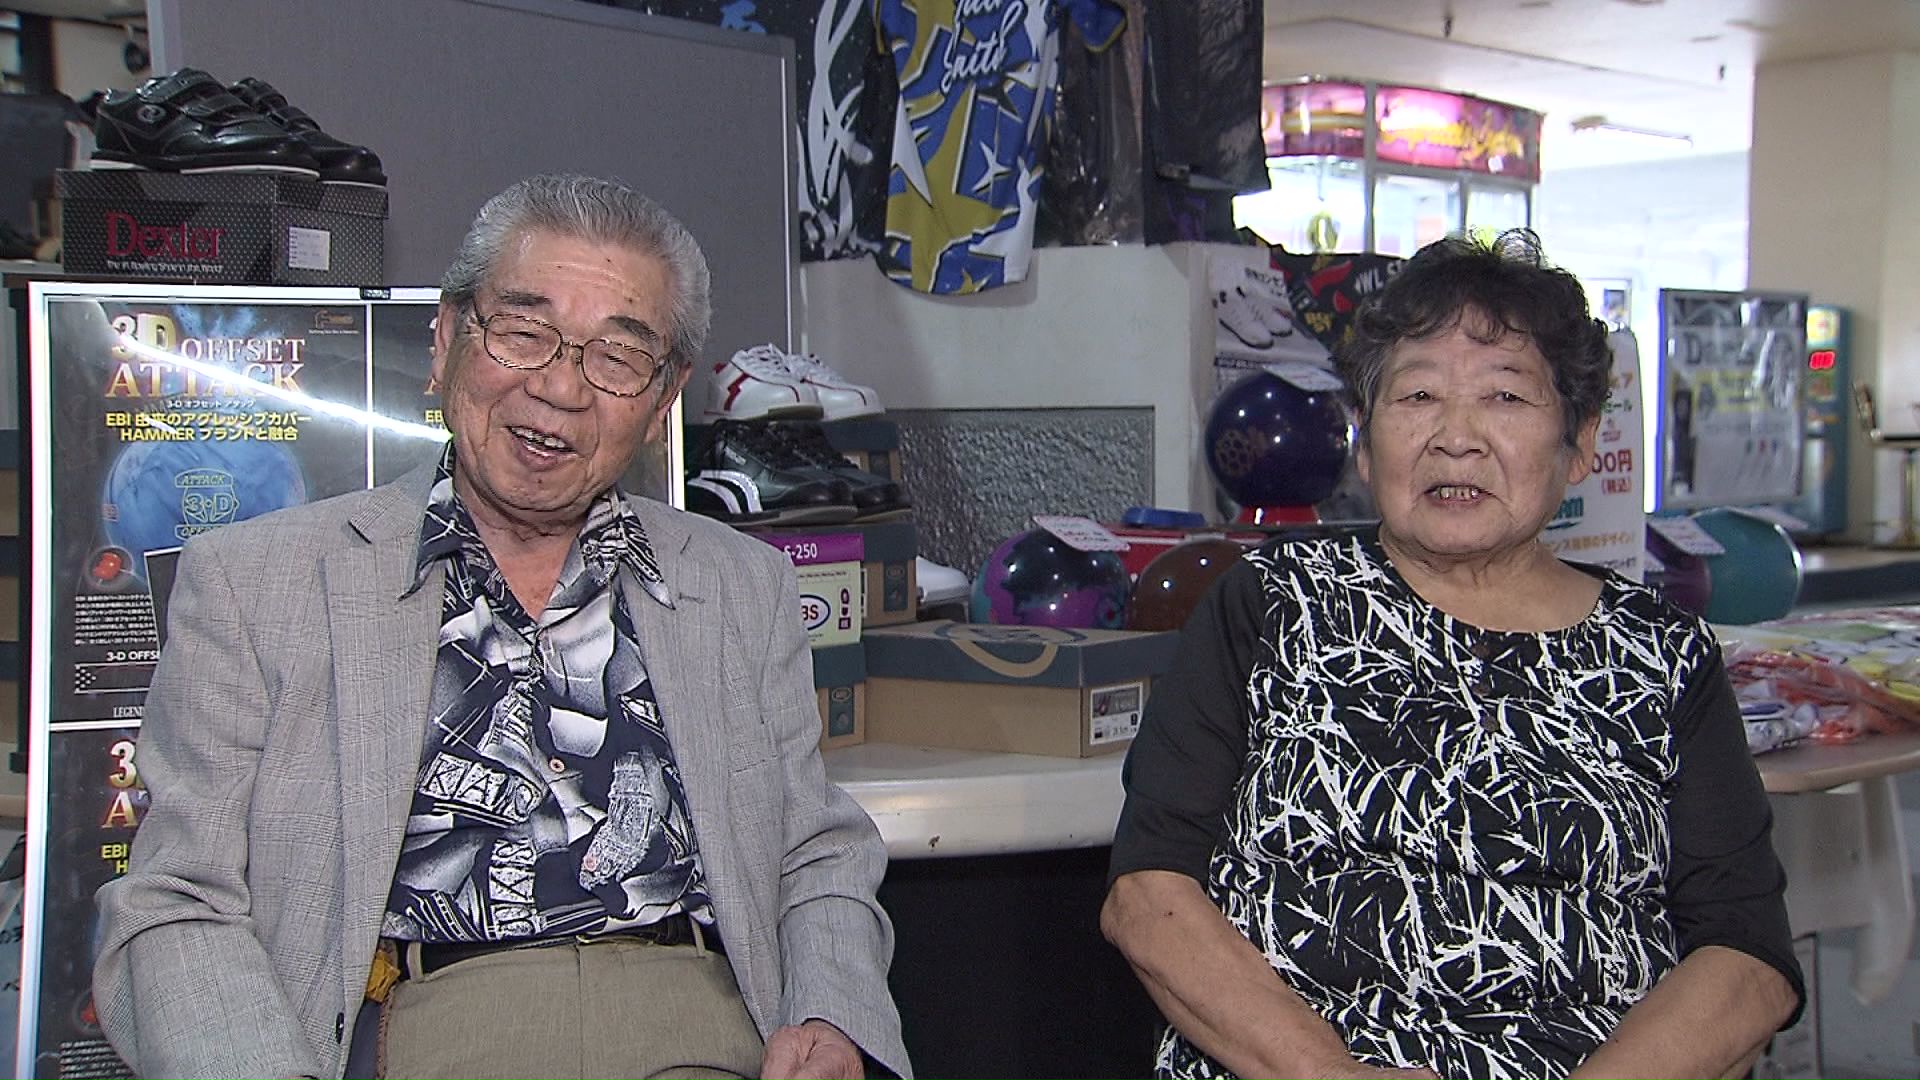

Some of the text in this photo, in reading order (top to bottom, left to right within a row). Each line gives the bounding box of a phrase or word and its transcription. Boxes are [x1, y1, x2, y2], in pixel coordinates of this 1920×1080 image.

[105, 210, 225, 259] Dexter
[181, 338, 306, 362] OFFSET
[105, 413, 131, 426] EBI
[121, 427, 298, 441] HAMMER ブランドと融合
[107, 651, 126, 662] 3-D
[102, 844, 127, 859] EBI
